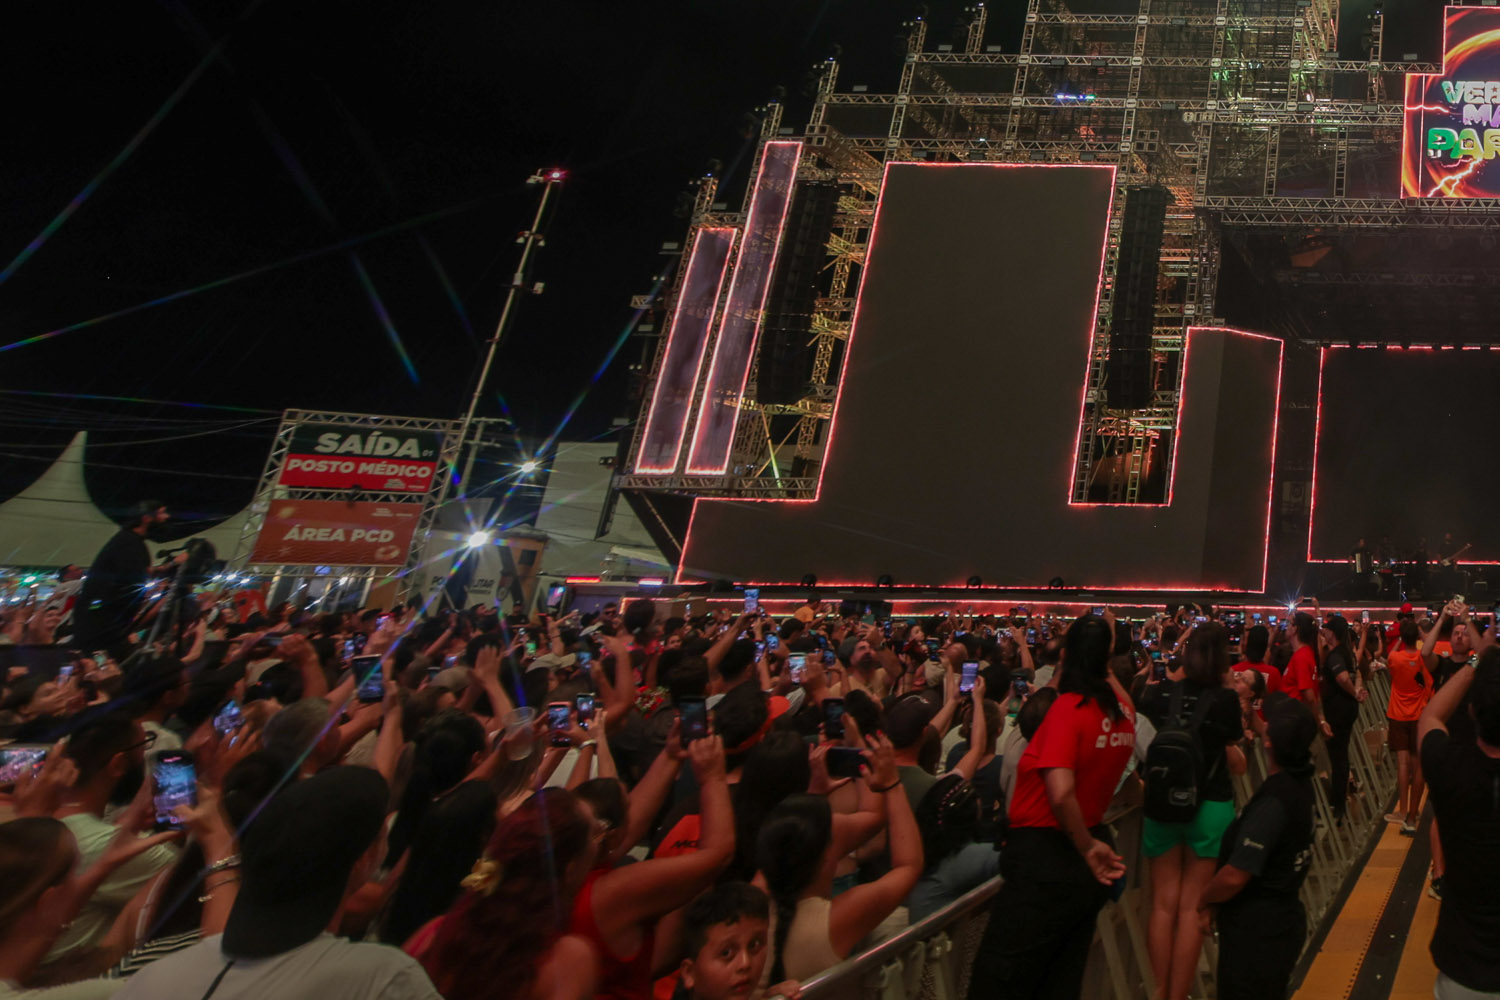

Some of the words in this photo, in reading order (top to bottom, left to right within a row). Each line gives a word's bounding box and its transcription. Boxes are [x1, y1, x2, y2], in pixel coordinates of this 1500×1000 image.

[314, 431, 420, 458] SAÍDA
[286, 459, 354, 474] POSTO
[357, 461, 431, 478] MÉDICO
[283, 524, 345, 542] ÁREA
[351, 529, 395, 543] PCD
